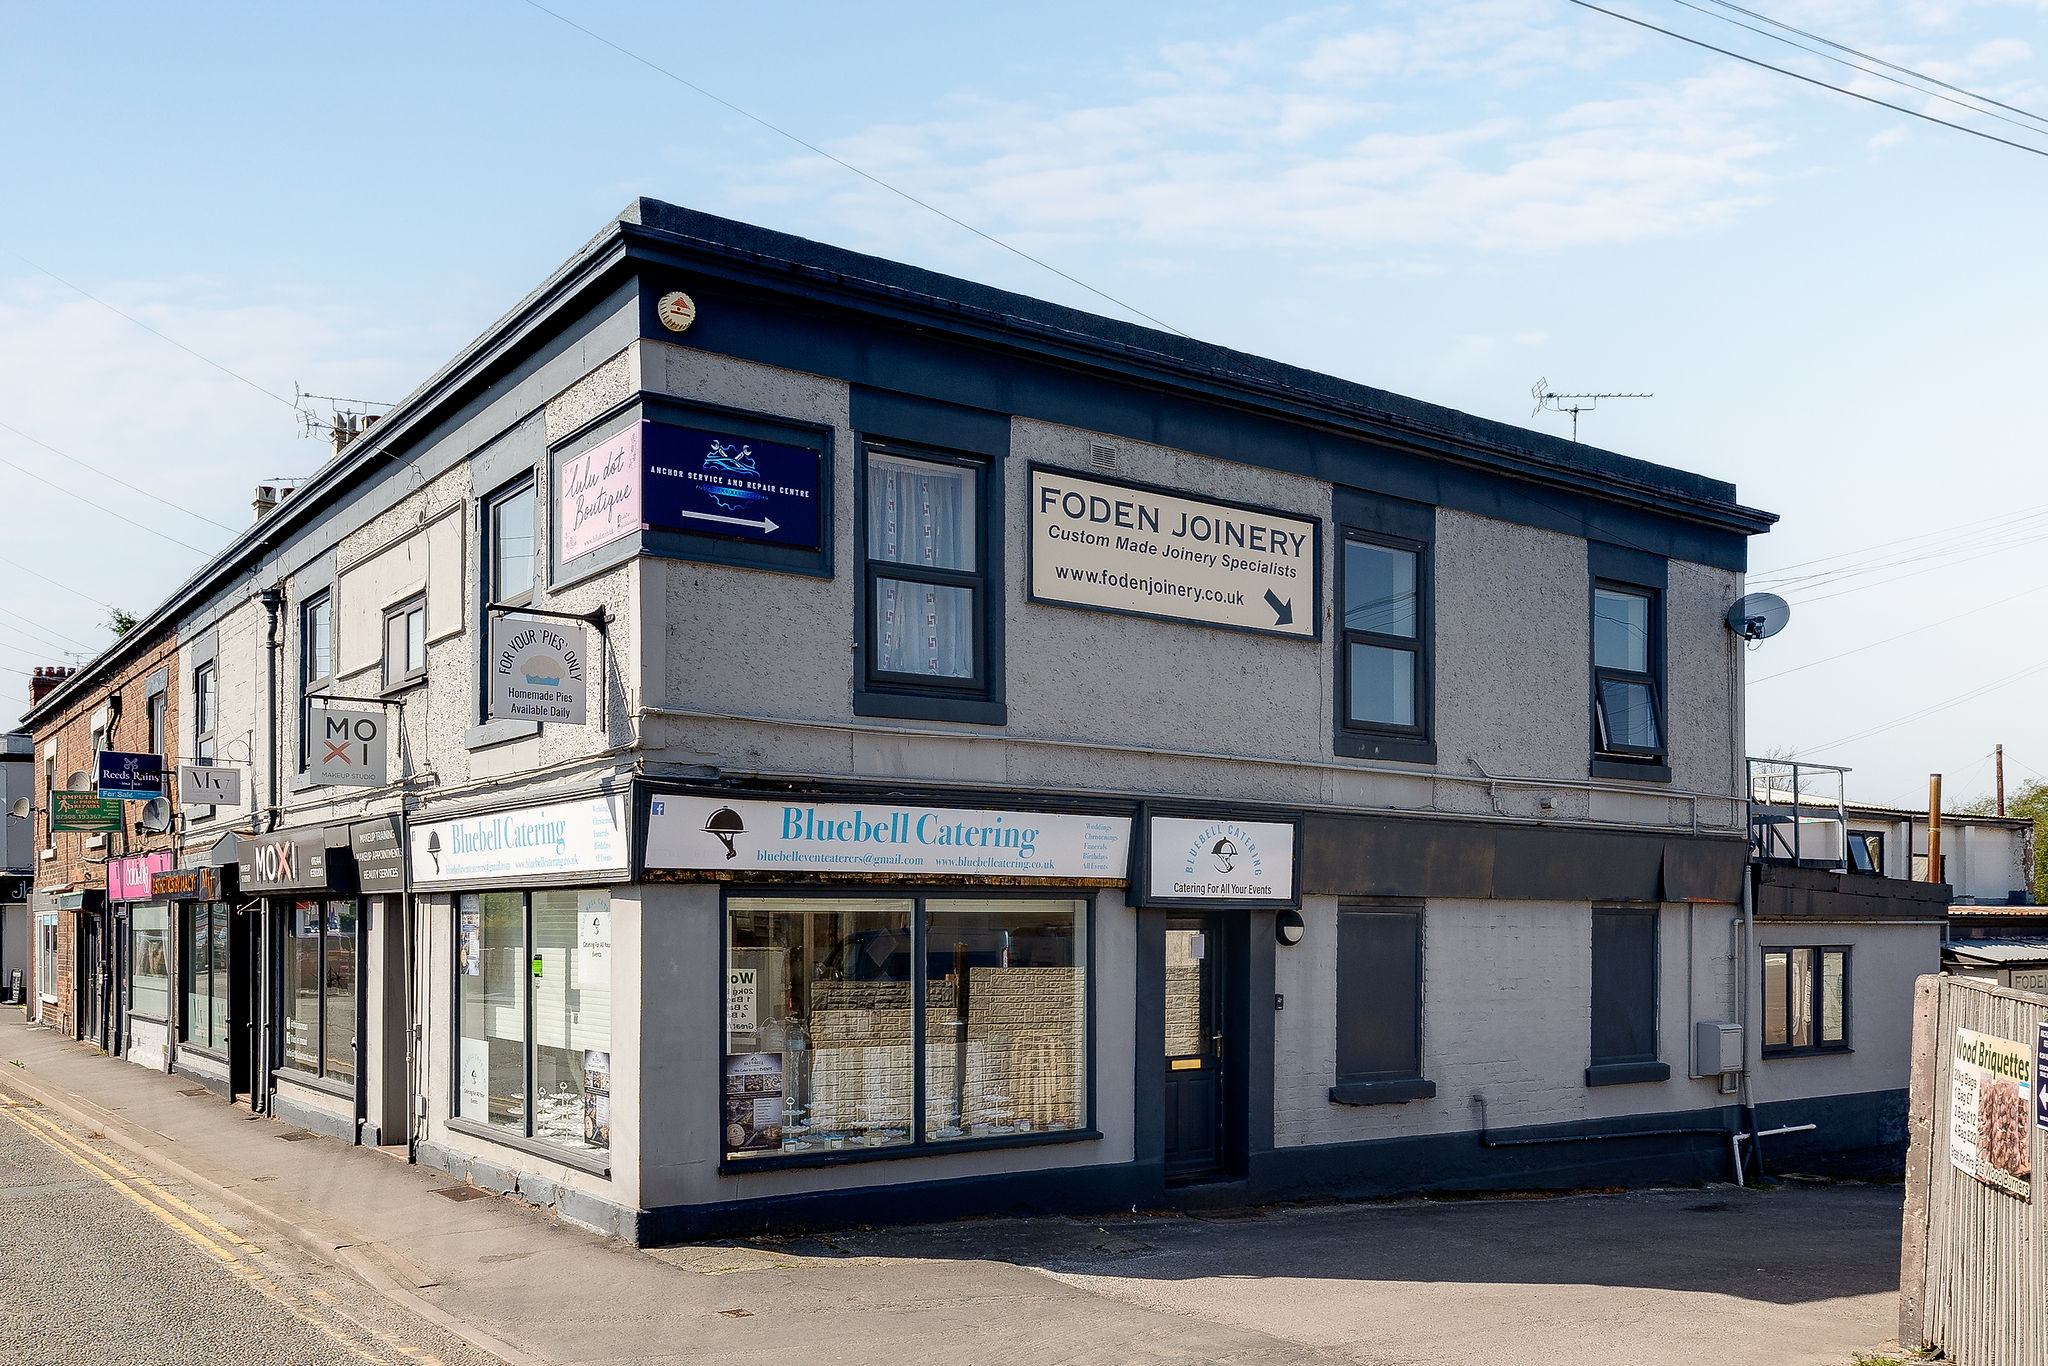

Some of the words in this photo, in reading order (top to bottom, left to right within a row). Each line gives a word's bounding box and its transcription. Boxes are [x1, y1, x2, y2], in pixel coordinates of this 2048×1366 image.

[603, 447, 625, 480] dot
[650, 465, 683, 477] ANCHOR
[688, 472, 723, 484] SERVICE
[727, 478, 743, 487] AND
[747, 482, 776, 493] REPAIR
[779, 487, 810, 498] CENTRE
[573, 484, 632, 531] Boutique
[1040, 486, 1160, 534] FODEN
[1171, 513, 1306, 558] JOINERY
[1048, 524, 1110, 547] Custom
[1116, 536, 1158, 555] Made
[1162, 544, 1217, 568] Joinery
[1221, 554, 1297, 578] Specialists
[1055, 565, 1245, 606] www.fodenjoinery.co.uk
[498, 651, 516, 675] FOR
[508, 629, 537, 653] YOUR
[563, 650, 582, 681] ONLY
[508, 687, 554, 701] Homemade
[556, 691, 573, 703] Pies
[511, 703, 548, 716] Available
[550, 706, 570, 719] Daily
[103, 769, 130, 780] Reeds
[133, 770, 160, 782] Rains
[322, 771, 350, 779] MAKEUP
[351, 773, 376, 781] STUDIO
[102, 790, 116, 798] For
[376, 829, 395, 841] TRAINING
[452, 818, 501, 855] Bluebell
[504, 811, 566, 856] Catering
[779, 806, 910, 845] Bluebell
[916, 812, 1040, 859] Catering
[1085, 823, 1113, 832] Weddings
[1083, 842, 1108, 851] Funerals
[1185, 824, 1222, 874] BLUEBELL
[1227, 824, 1262, 876] CATERING
[255, 841, 297, 882] MOXI
[756, 849, 924, 867] bluebelleventcaterers@gmail.com
[935, 857, 1055, 871] www.bluebellcatering.co.uk
[1082, 852, 1109, 861] Birthdays
[1090, 862, 1109, 870] Events
[363, 869, 378, 880] BEAUTY
[379, 867, 399, 878] SERVICES
[1174, 882, 1206, 895] Catering
[1207, 882, 1219, 893] For
[1221, 883, 1230, 894] All
[1232, 884, 1248, 894] Your
[1249, 884, 1272, 895] Events
[2015, 974, 2048, 989] FODE
[1957, 1034, 1978, 1064] Wood
[1978, 1041, 2030, 1082] Briquettes
[1965, 1072, 1976, 1091] Bags
[1958, 1088, 1966, 1106] Bag
[1958, 1106, 1966, 1124] Bag
[1958, 1124, 1966, 1143] Bag
[1985, 1161, 2003, 1186] Wood
[2003, 1169, 2030, 1198] Burners
